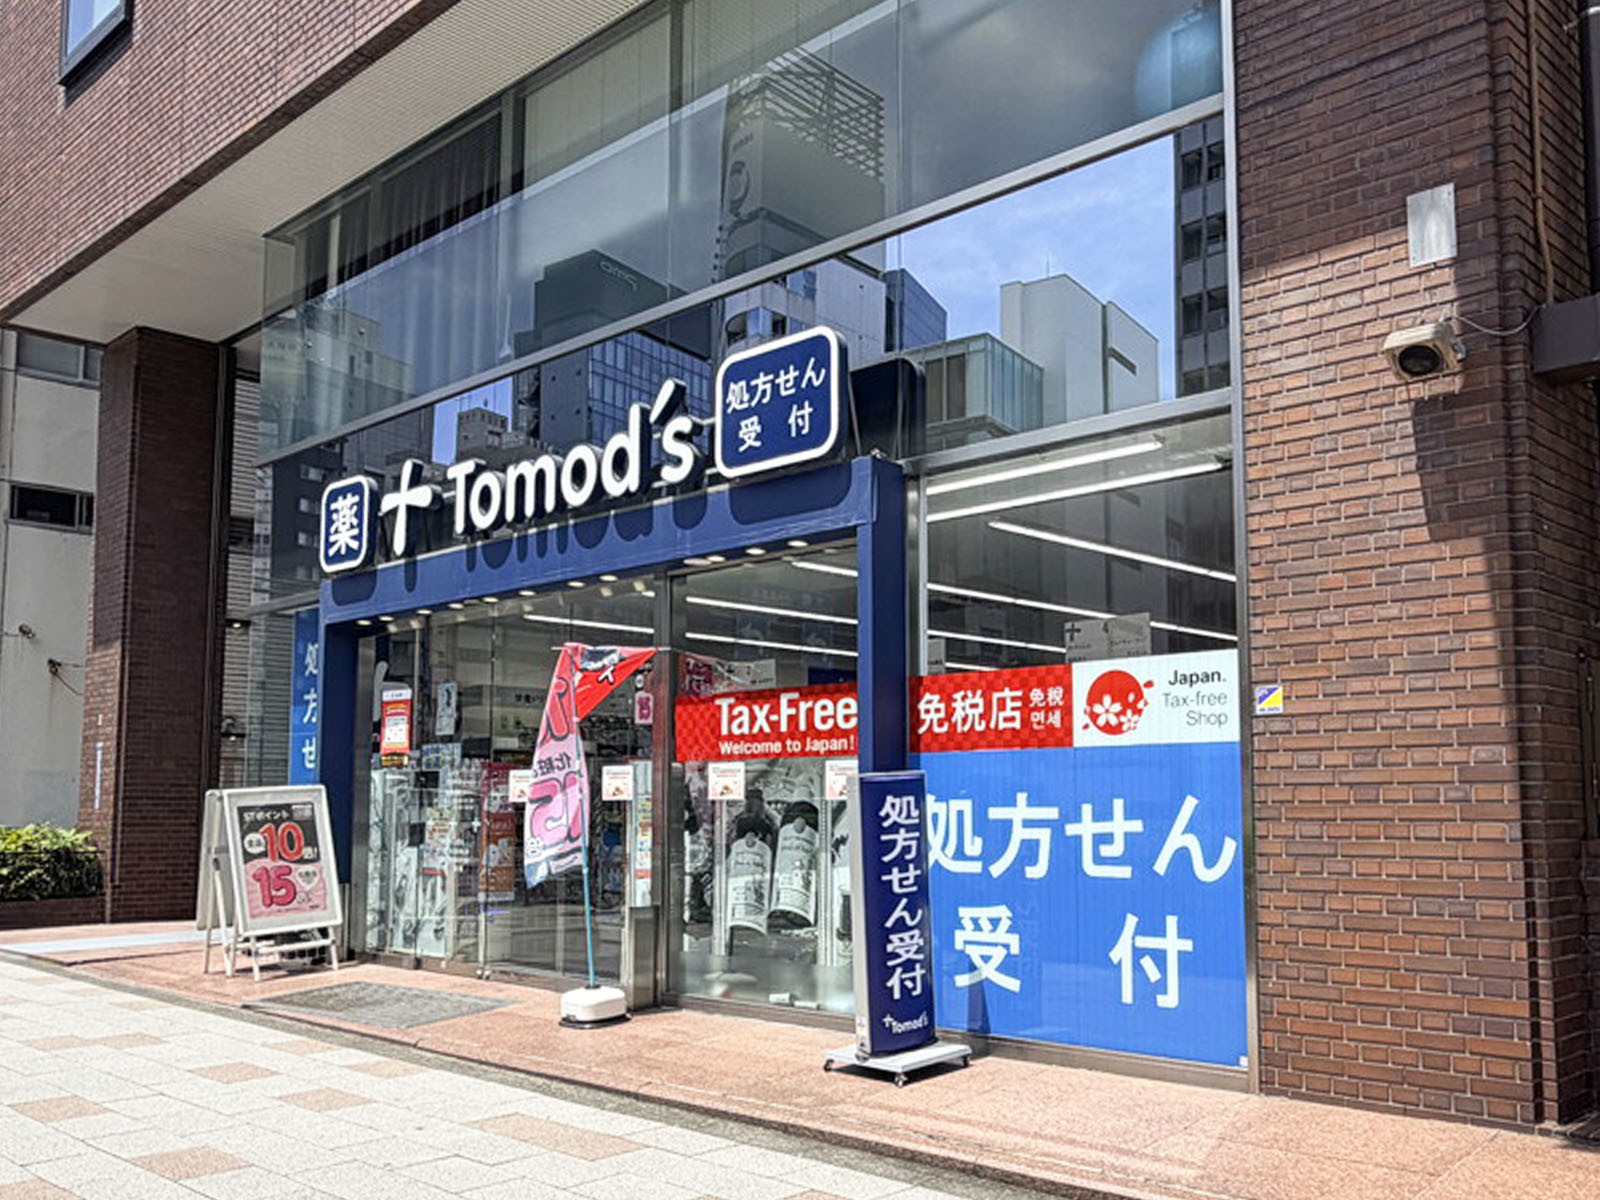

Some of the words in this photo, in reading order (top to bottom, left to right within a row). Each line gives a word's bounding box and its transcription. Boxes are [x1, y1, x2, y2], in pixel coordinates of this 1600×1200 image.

[725, 356, 826, 413] 処方せん
[446, 379, 694, 535] Tomod's
[328, 493, 360, 558] 薬
[1162, 690, 1228, 708] Tax-free
[1168, 669, 1227, 688] Japan.
[713, 691, 858, 736] Tax-Free
[917, 687, 1023, 734] 免税店
[1185, 710, 1228, 727] Shop
[718, 740, 782, 755] Welcome
[785, 739, 801, 753] to
[258, 821, 305, 863] 10
[926, 792, 1237, 883] 処方せん
[252, 864, 298, 909] 15
[878, 794, 927, 1001] 処方せん受付
[891, 1010, 929, 1035] Tomod's
